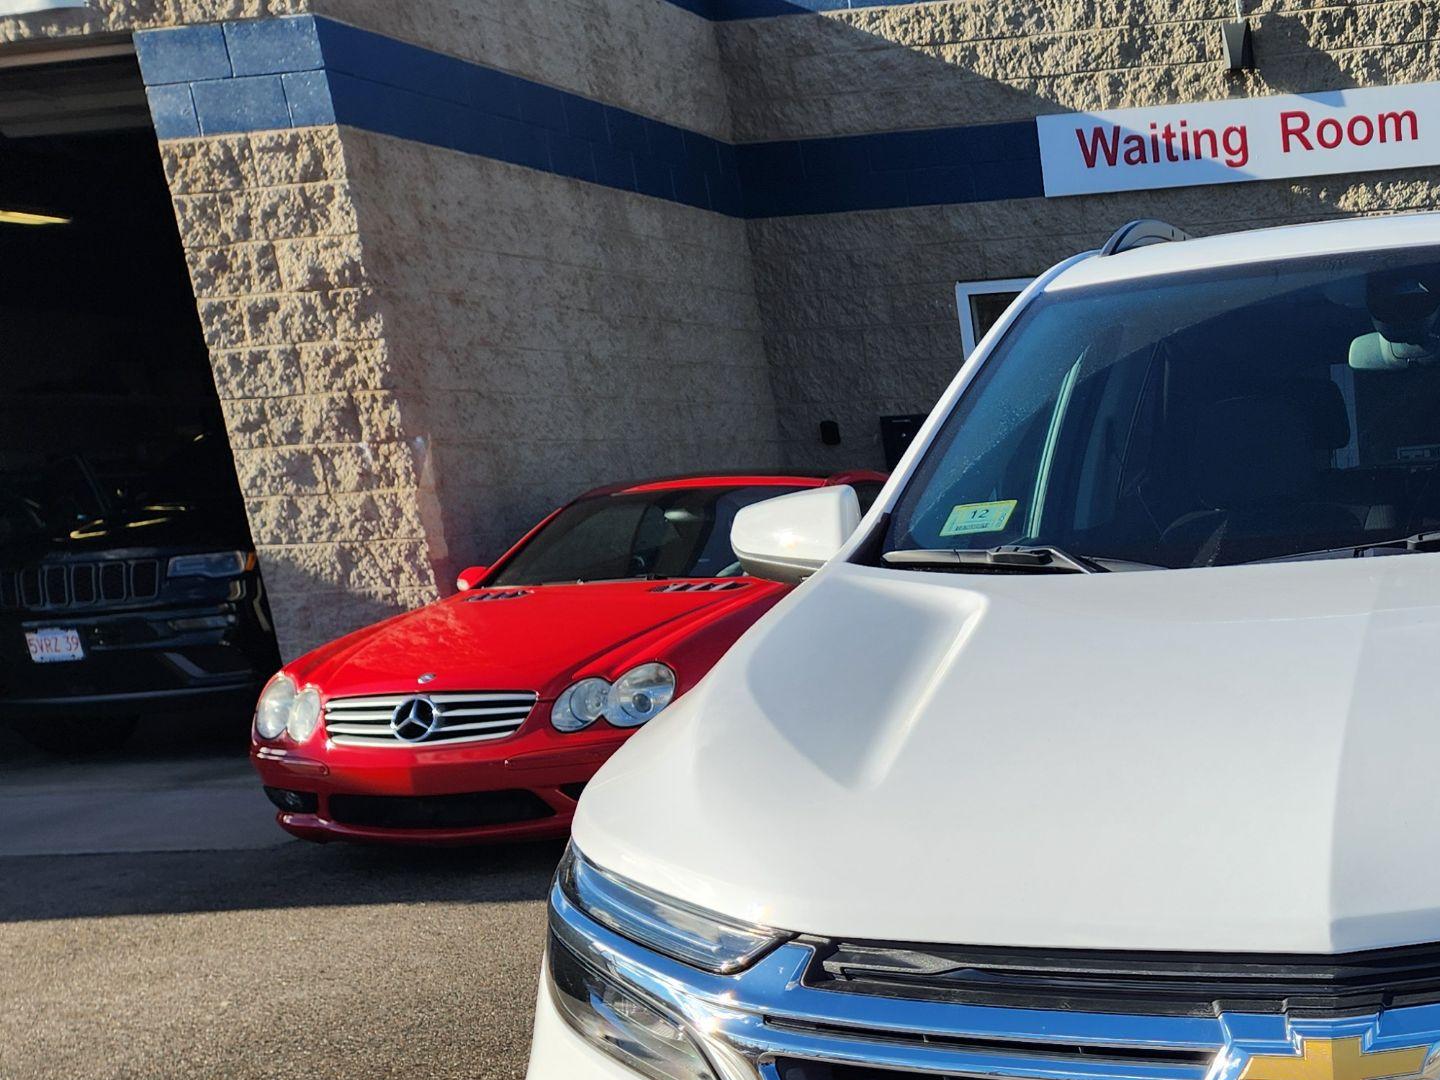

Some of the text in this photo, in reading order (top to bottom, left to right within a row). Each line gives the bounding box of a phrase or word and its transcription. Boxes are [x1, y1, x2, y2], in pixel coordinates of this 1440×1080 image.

[1075, 109, 1419, 168] Waiting Room
[970, 509, 989, 519] 12
[28, 635, 79, 654] 5VRZ 39
